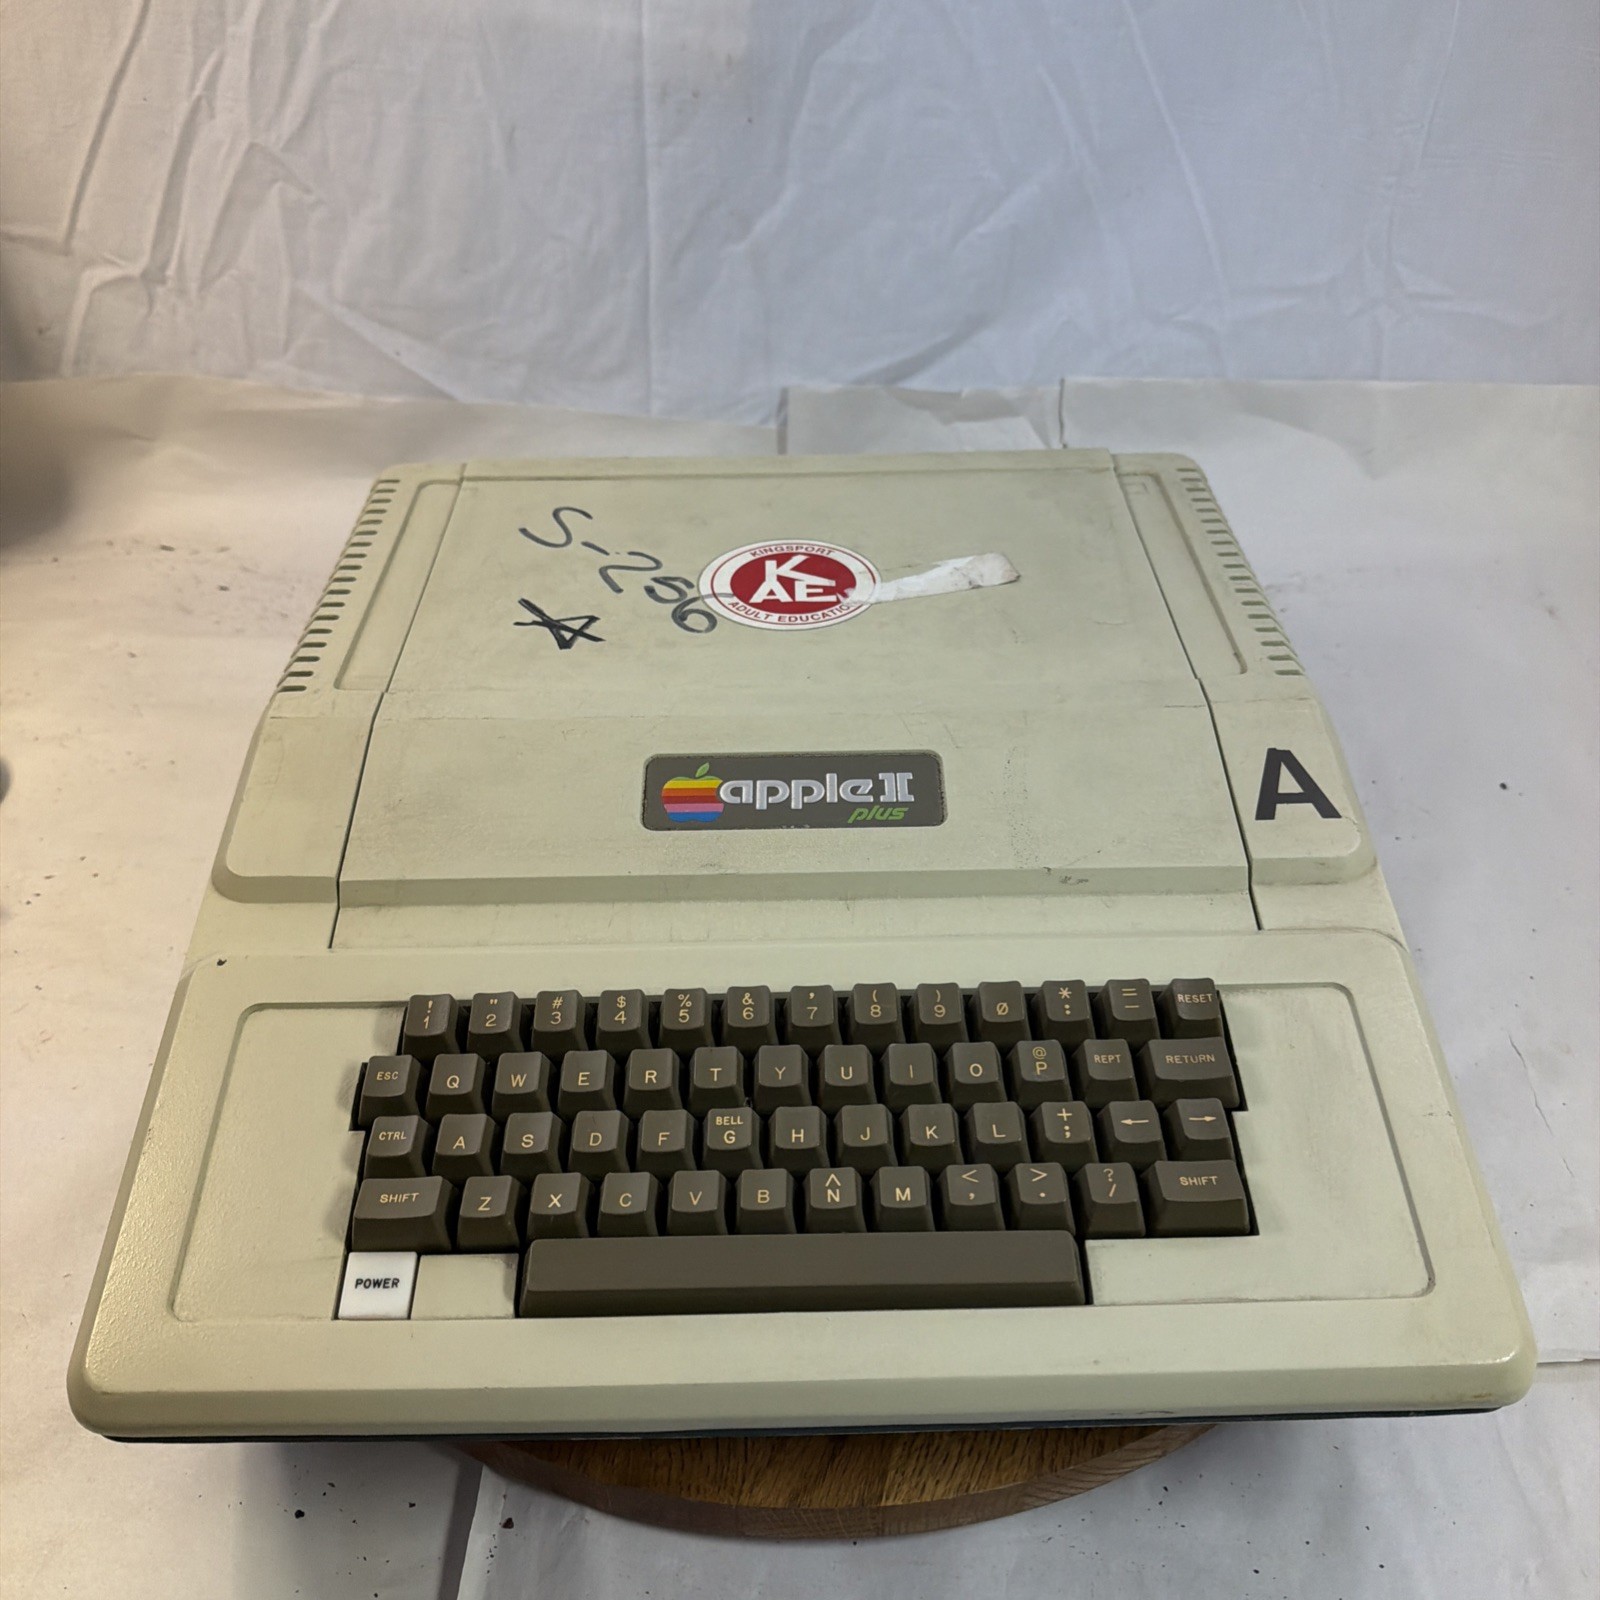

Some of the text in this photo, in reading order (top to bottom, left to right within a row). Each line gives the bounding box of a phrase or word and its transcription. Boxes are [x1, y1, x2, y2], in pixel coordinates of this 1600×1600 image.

[750, 545, 837, 558] KINGSPORT
[728, 601, 856, 623] ADULT EDUCATIO
[719, 772, 874, 810] apple
[1255, 748, 1342, 820] A
[848, 804, 909, 824] plus
[551, 996, 564, 1009] #
[616, 995, 627, 1009] $
[677, 993, 693, 1008] %
[742, 992, 755, 1006] &
[1177, 993, 1212, 1004] RESET
[550, 1011, 562, 1025] 3
[614, 1010, 627, 1025] 4
[678, 1008, 690, 1023] 5
[742, 1006, 754, 1020] 6
[806, 1006, 818, 1020] 7
[870, 1004, 882, 1018] 8
[933, 1004, 946, 1018] 9
[485, 1013, 497, 1027] 2
[1032, 1046, 1047, 1060] @
[1093, 1054, 1121, 1064] REPT
[1165, 1054, 1216, 1064] RETURN
[376, 1071, 399, 1081] ESC
[709, 1067, 722, 1082] T
[774, 1066, 786, 1080] Y
[840, 1066, 853, 1080] U
[969, 1063, 983, 1078] O
[1035, 1061, 1048, 1076] P
[446, 1074, 460, 1089] Q
[510, 1073, 527, 1088] W
[578, 1071, 591, 1086] E
[644, 1069, 658, 1084] R
[715, 1115, 744, 1126] BELL
[1056, 1107, 1073, 1122] +
[378, 1131, 407, 1141] CTRL
[658, 1131, 671, 1146] F
[723, 1130, 736, 1144] G
[791, 1128, 805, 1143] H
[860, 1126, 871, 1141] J
[925, 1125, 939, 1140] K
[992, 1124, 1006, 1138] L
[452, 1135, 466, 1150] A
[521, 1133, 534, 1148] S
[589, 1132, 603, 1147] D
[961, 1169, 979, 1183] <
[1030, 1168, 1048, 1182] >
[1103, 1168, 1114, 1182] ?
[1179, 1175, 1218, 1186] SHIFT
[379, 1192, 420, 1204] SHIFT
[548, 1193, 562, 1208] X
[619, 1192, 632, 1208] C
[689, 1191, 703, 1206] V
[757, 1189, 770, 1204] B
[827, 1188, 840, 1203] N
[895, 1187, 911, 1202] M
[477, 1196, 492, 1211] Z
[353, 1277, 400, 1290] POWER
